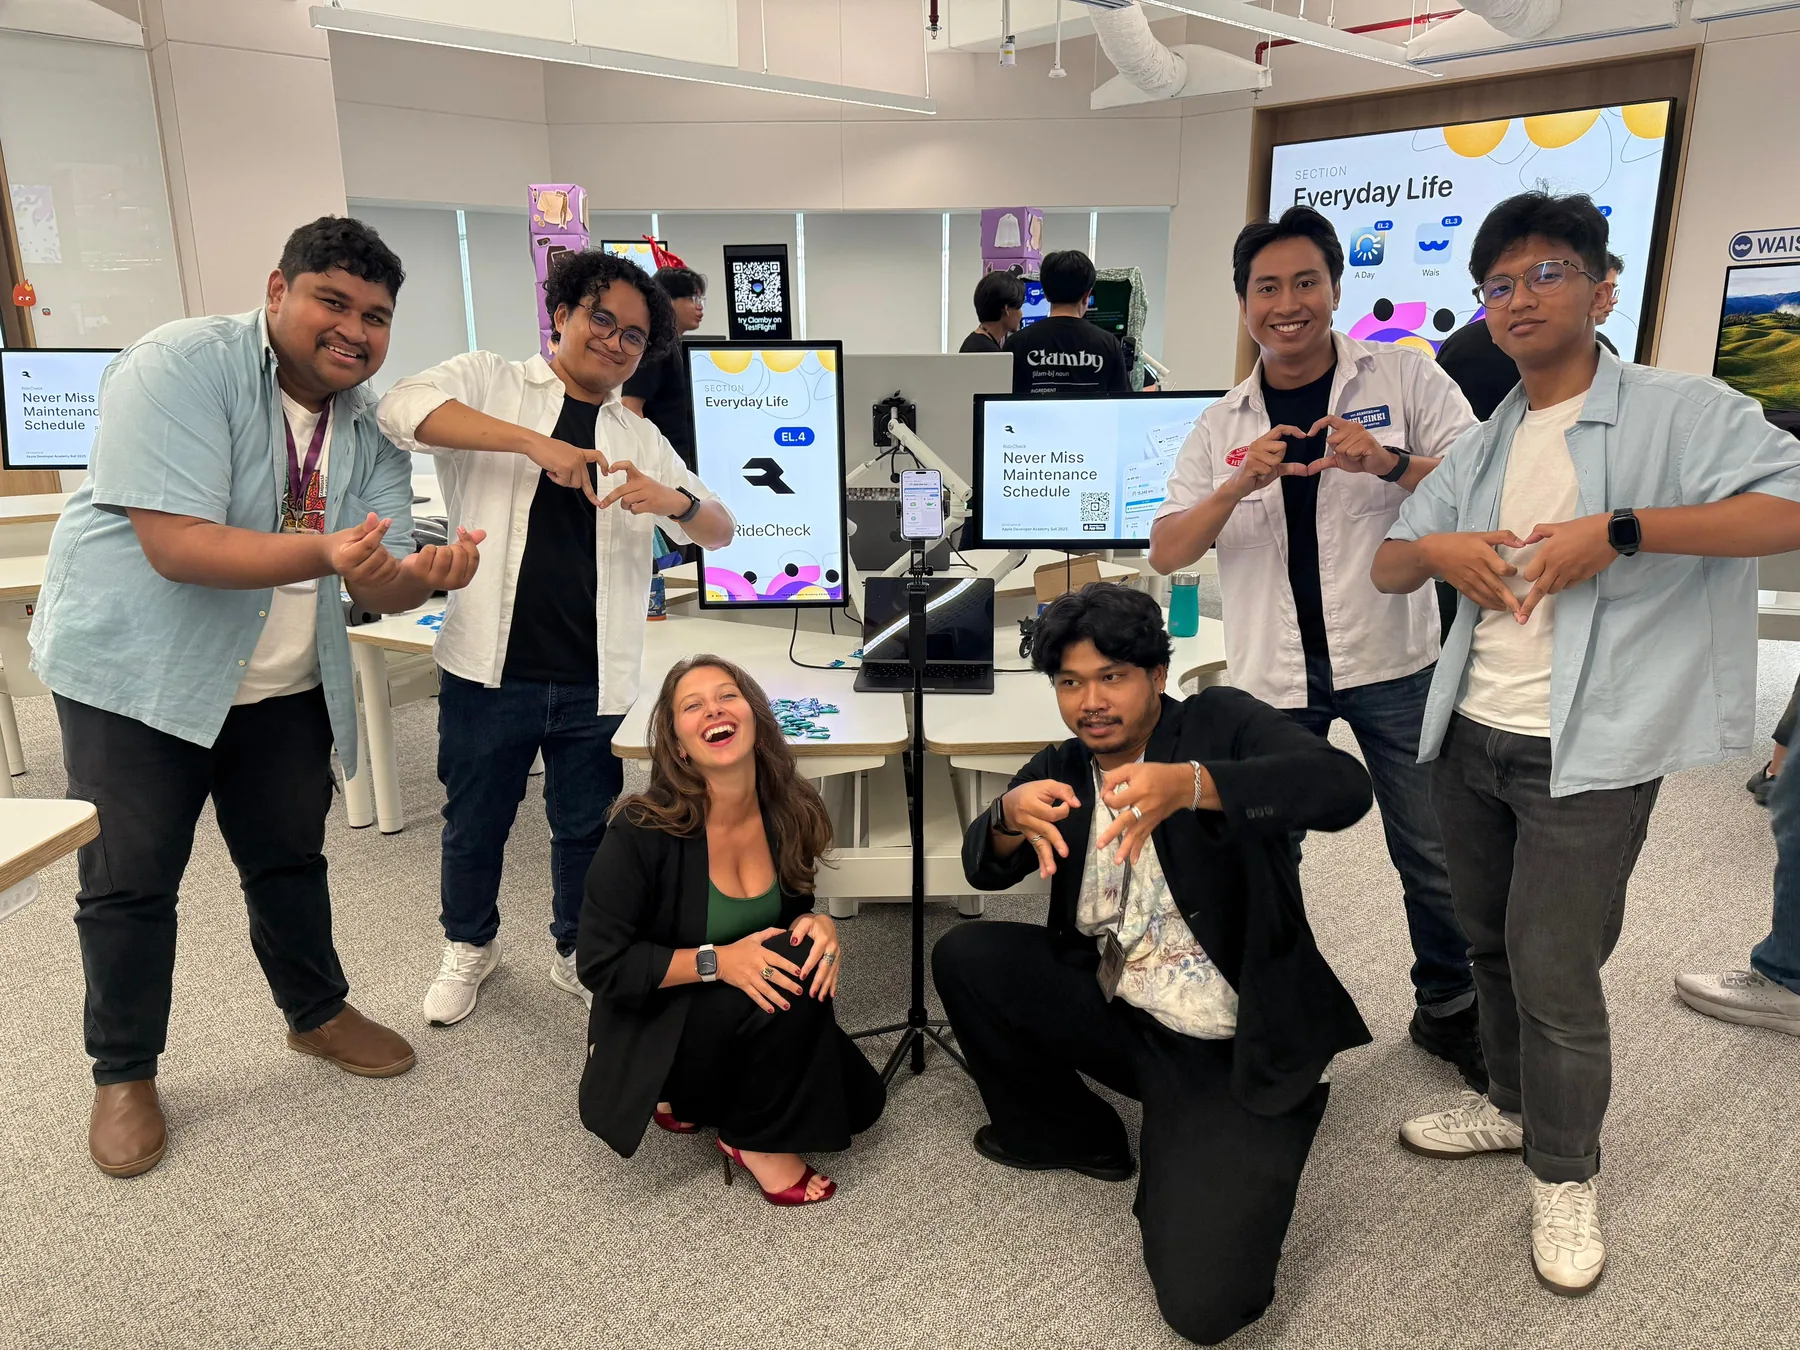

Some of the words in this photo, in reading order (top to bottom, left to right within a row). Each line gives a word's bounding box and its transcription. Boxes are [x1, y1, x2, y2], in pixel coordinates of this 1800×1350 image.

[1294, 165, 1348, 181] SECTION
[1293, 181, 1401, 211] Everyday
[1406, 175, 1453, 200] Life
[1354, 271, 1361, 279] A
[1361, 271, 1376, 280] Day
[1421, 268, 1440, 277] Wais
[737, 316, 747, 325] try
[747, 315, 773, 325] Clamby
[1026, 348, 1104, 374] Clamby
[704, 384, 745, 393] SECTION
[22, 392, 61, 403] Never
[65, 392, 95, 403] Miss
[705, 396, 763, 410] Everyday
[766, 395, 789, 407] Life
[23, 406, 100, 417] Maintenanc
[24, 419, 86, 431] Schedule
[781, 431, 806, 442] EL.4
[1003, 451, 1047, 464] Never
[1050, 450, 1085, 464] Miss
[1003, 468, 1098, 481] Maintenance
[1002, 485, 1071, 498] Schedule
[734, 523, 811, 537] RideCheck
